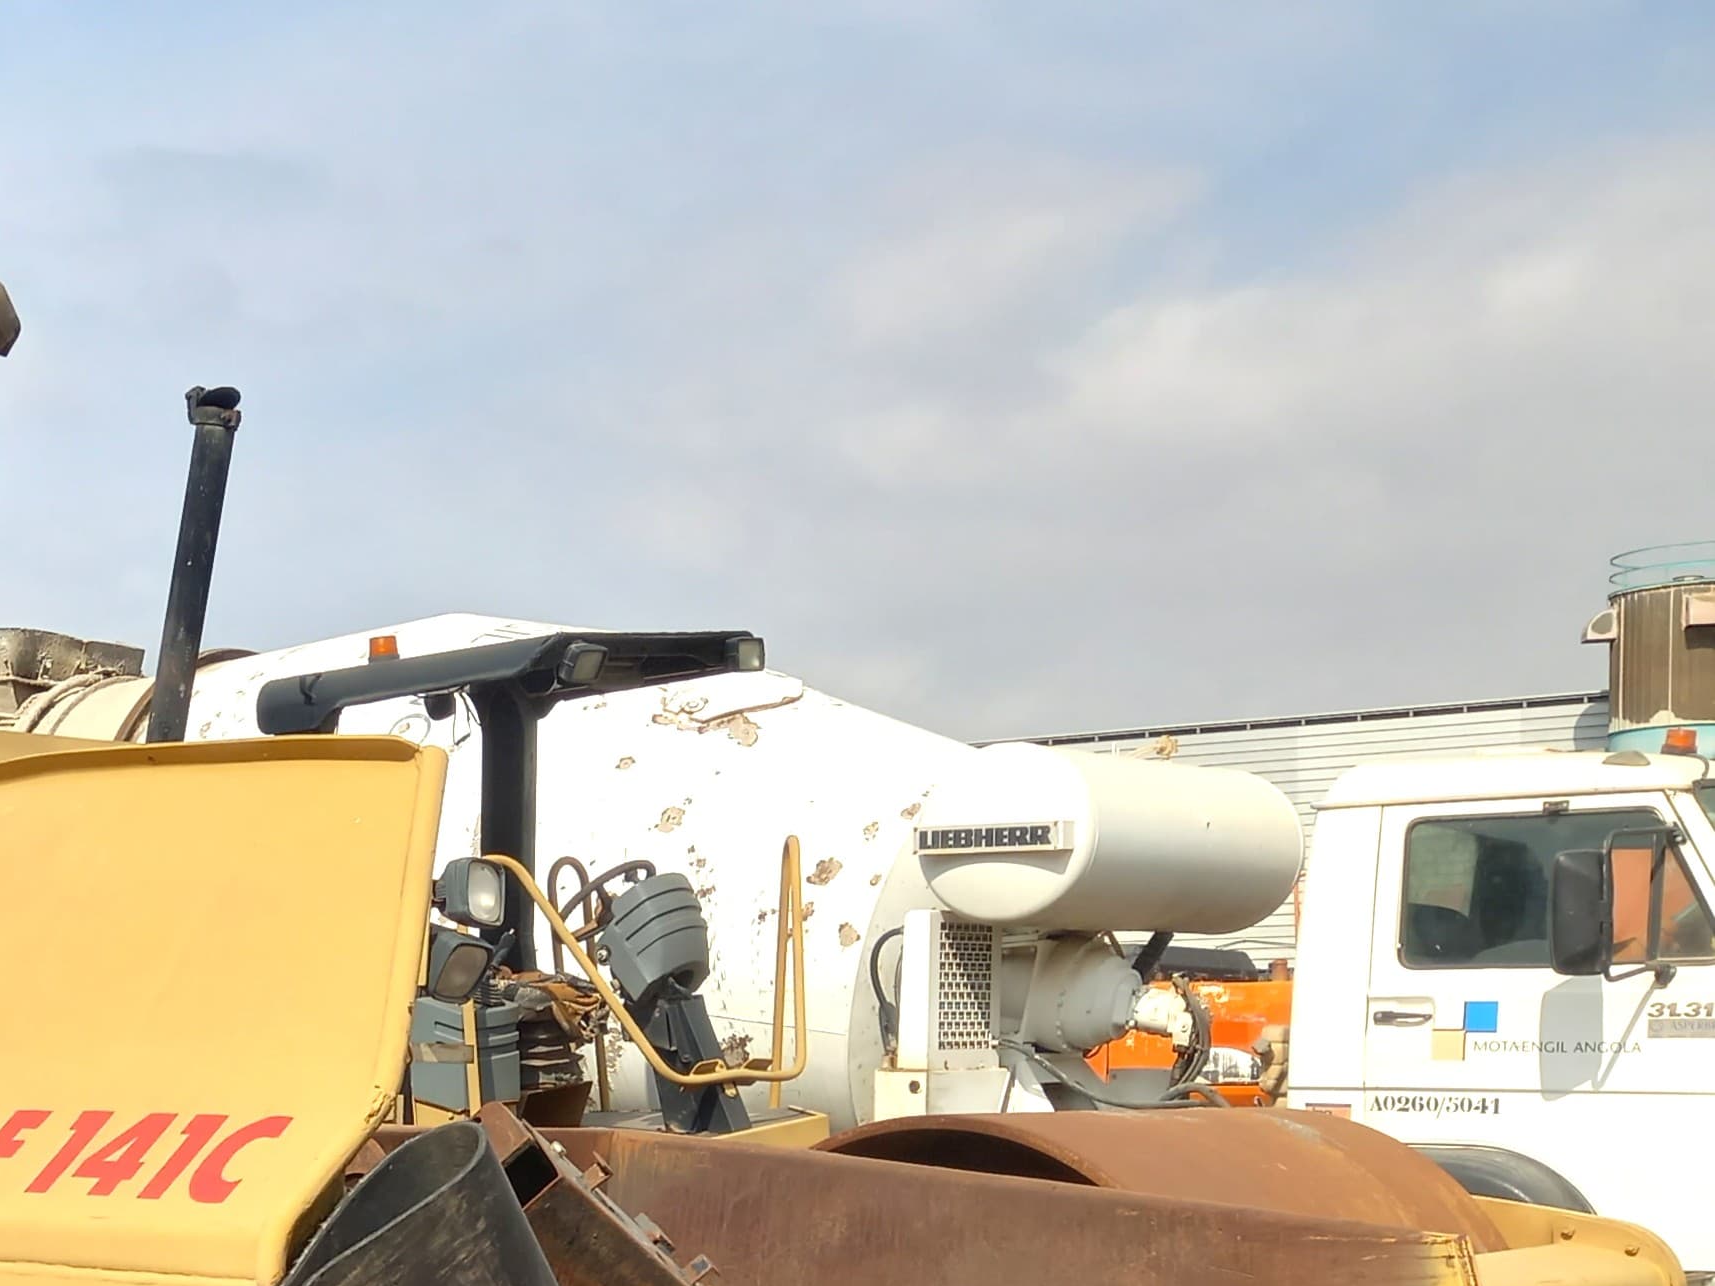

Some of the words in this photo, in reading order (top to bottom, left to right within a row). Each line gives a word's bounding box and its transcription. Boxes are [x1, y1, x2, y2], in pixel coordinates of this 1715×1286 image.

[918, 825, 1052, 850] LIEBHERR
[1573, 1041, 1643, 1055] ANGOLA
[1369, 1095, 1502, 1120] A0260/5041
